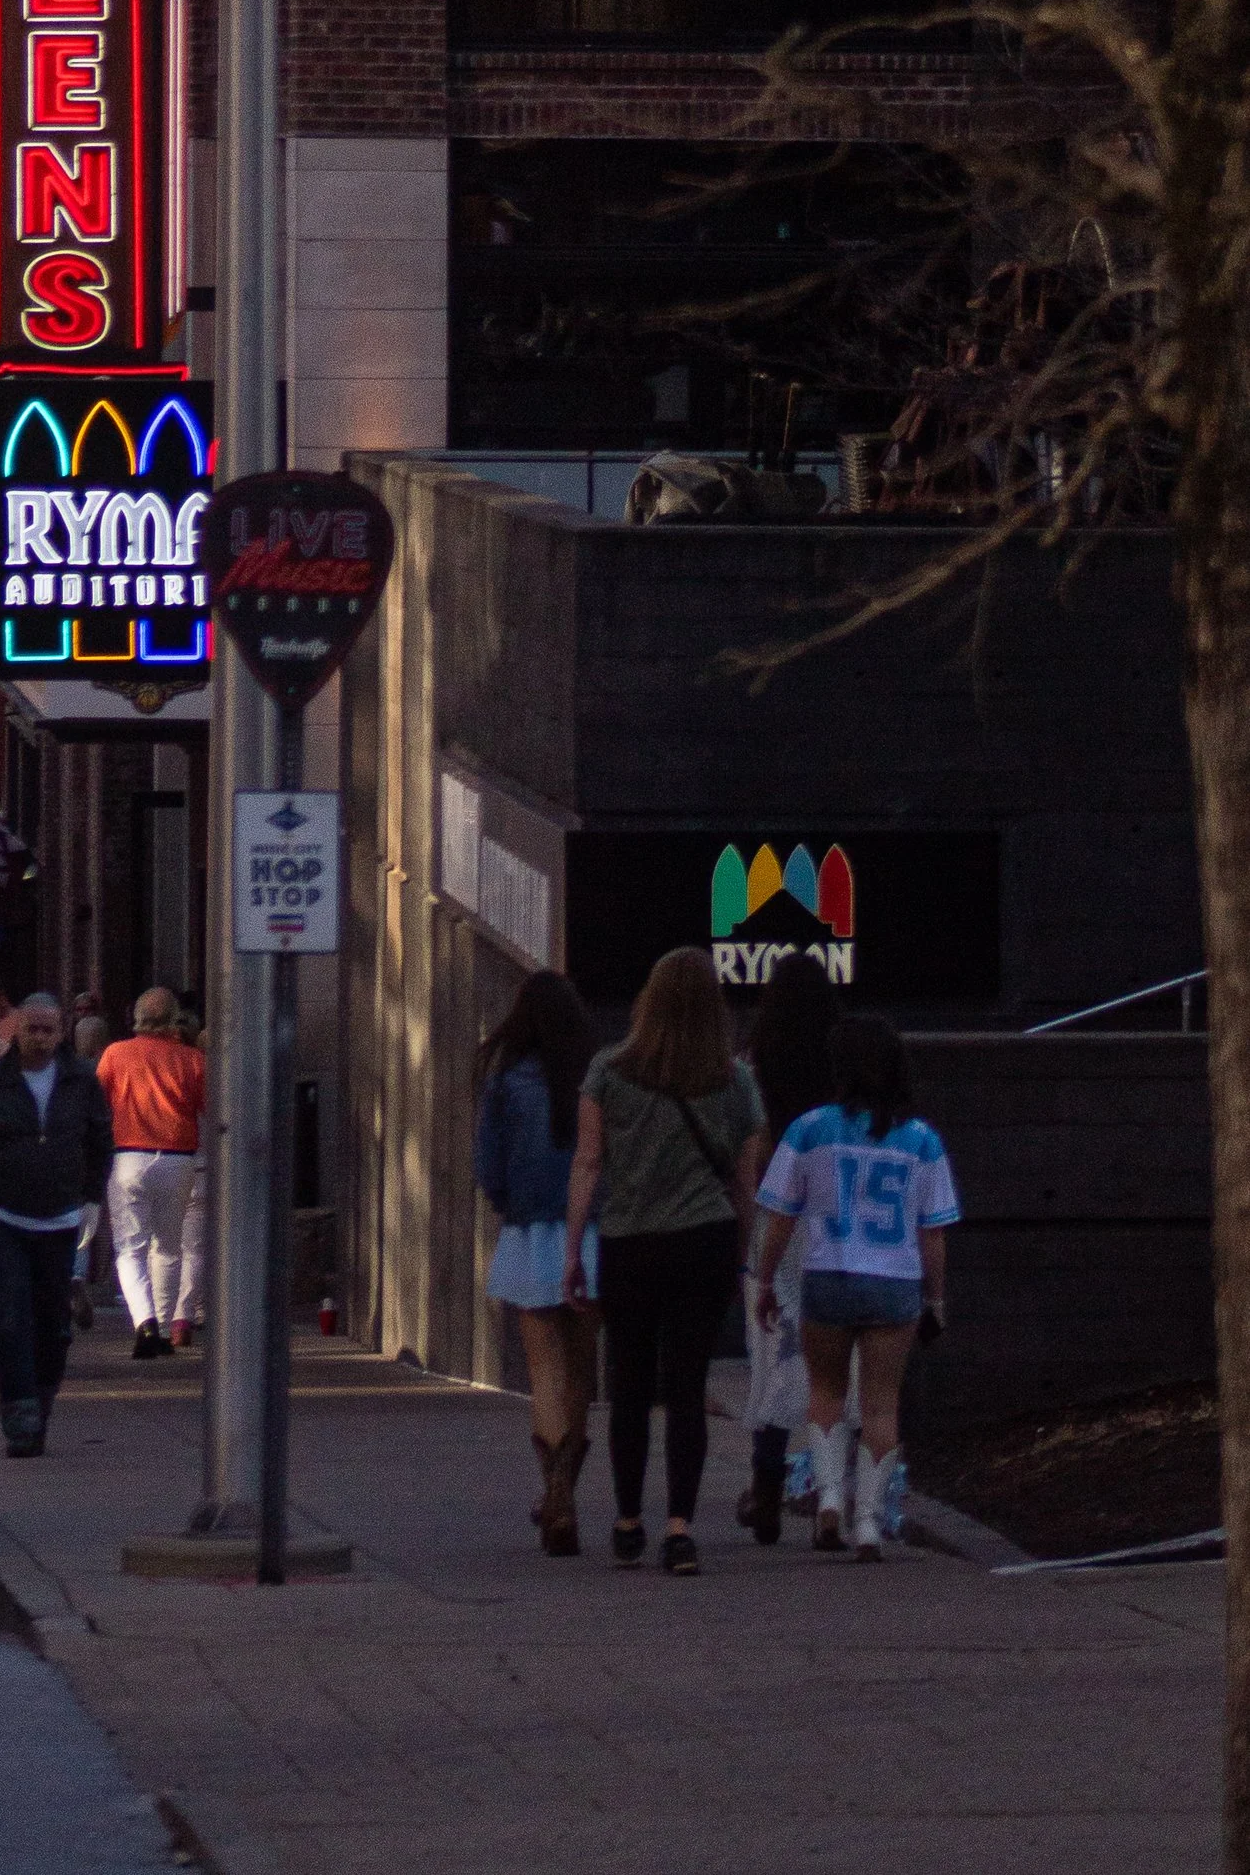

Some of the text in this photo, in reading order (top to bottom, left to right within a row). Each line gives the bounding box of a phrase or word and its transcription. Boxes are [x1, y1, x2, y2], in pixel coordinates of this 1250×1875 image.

[229, 508, 368, 559] LIVE
[251, 857, 322, 884] HOP
[251, 887, 321, 907] STOP
